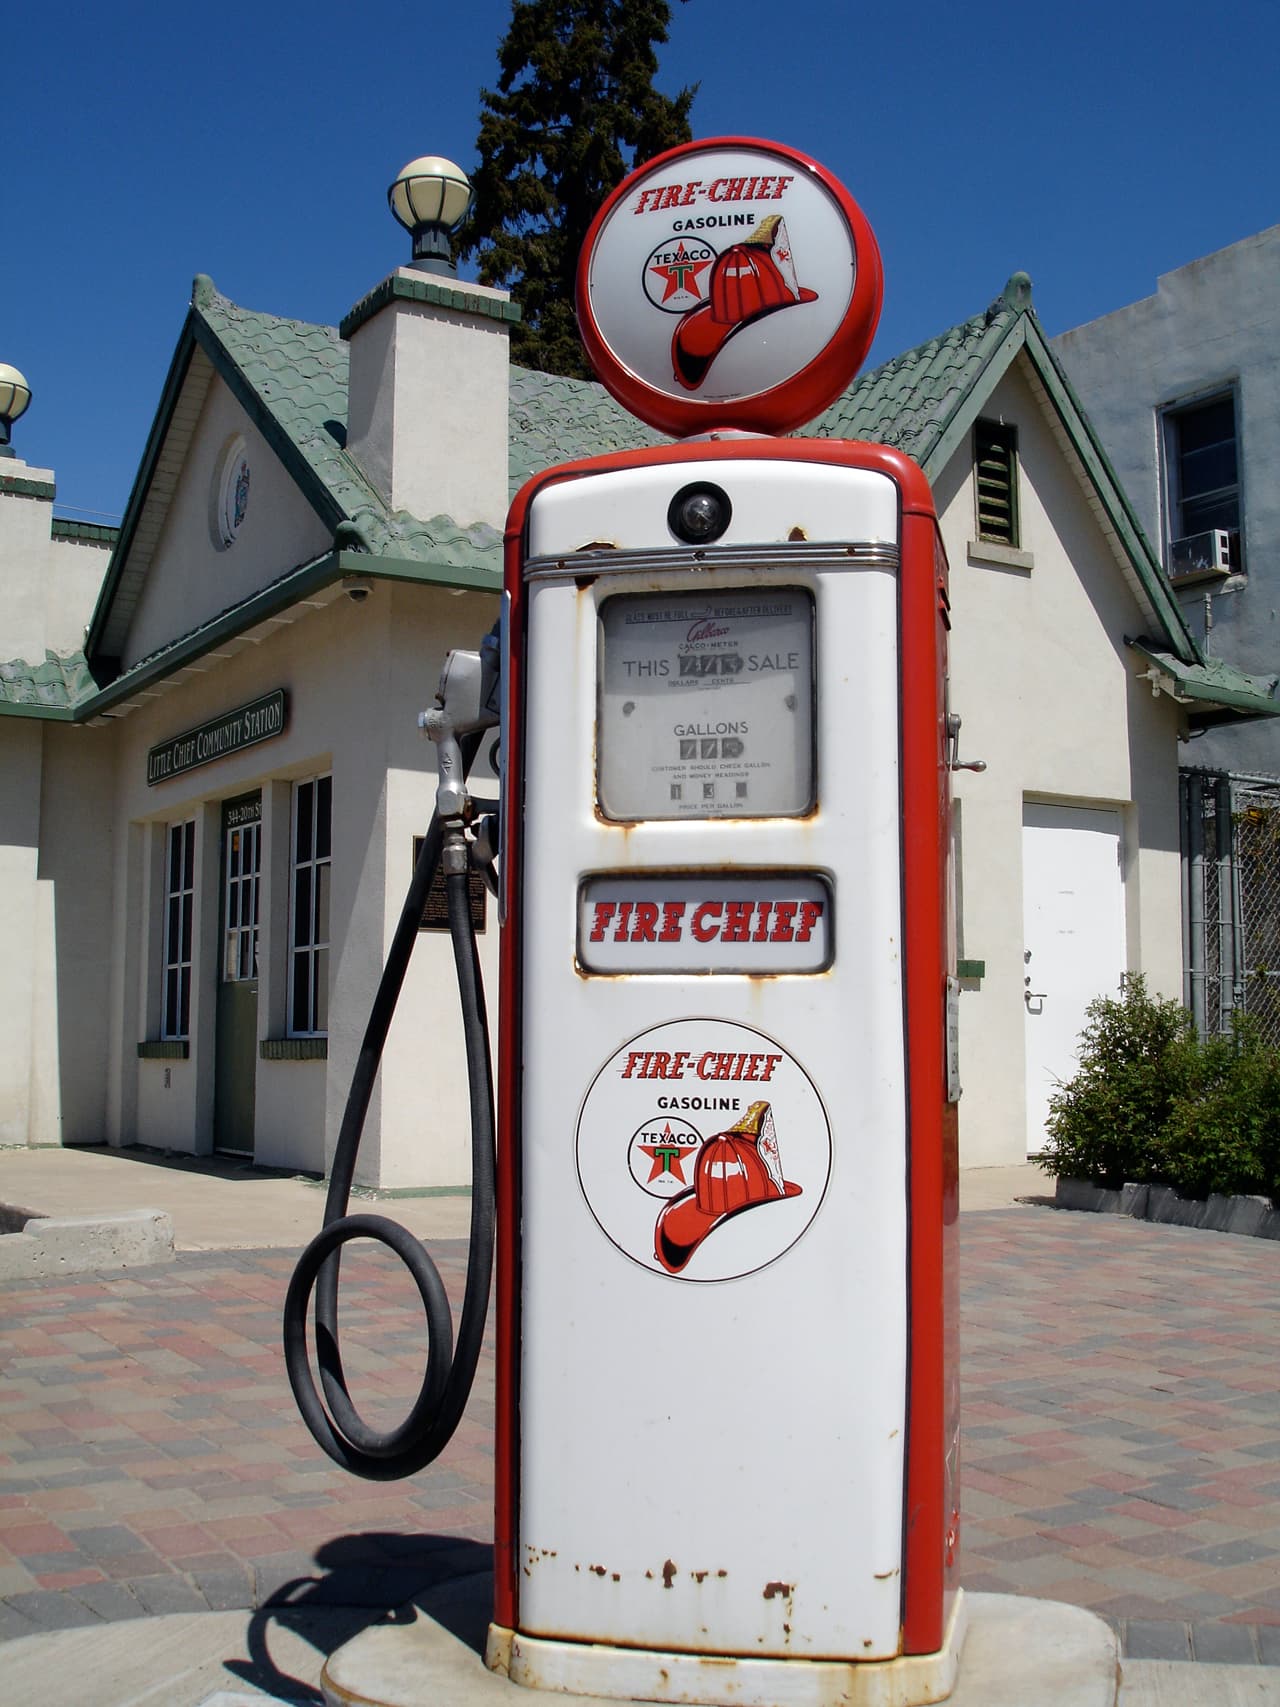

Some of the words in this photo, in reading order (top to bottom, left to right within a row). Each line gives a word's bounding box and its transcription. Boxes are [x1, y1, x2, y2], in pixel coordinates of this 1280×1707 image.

[632, 176, 794, 215] FIRE-CHIEF
[673, 213, 755, 232] GASOLINE
[653, 248, 712, 266] TEXACO
[622, 659, 670, 677] THIS
[748, 653, 800, 671] SALE
[673, 721, 748, 737] GALLONS
[589, 902, 685, 943] FIRE
[691, 901, 824, 943] CHIEF
[617, 1051, 782, 1081] FIRE-CHIEF
[657, 1097, 740, 1111] GASOLINE
[641, 1132, 697, 1145] TEXACO
